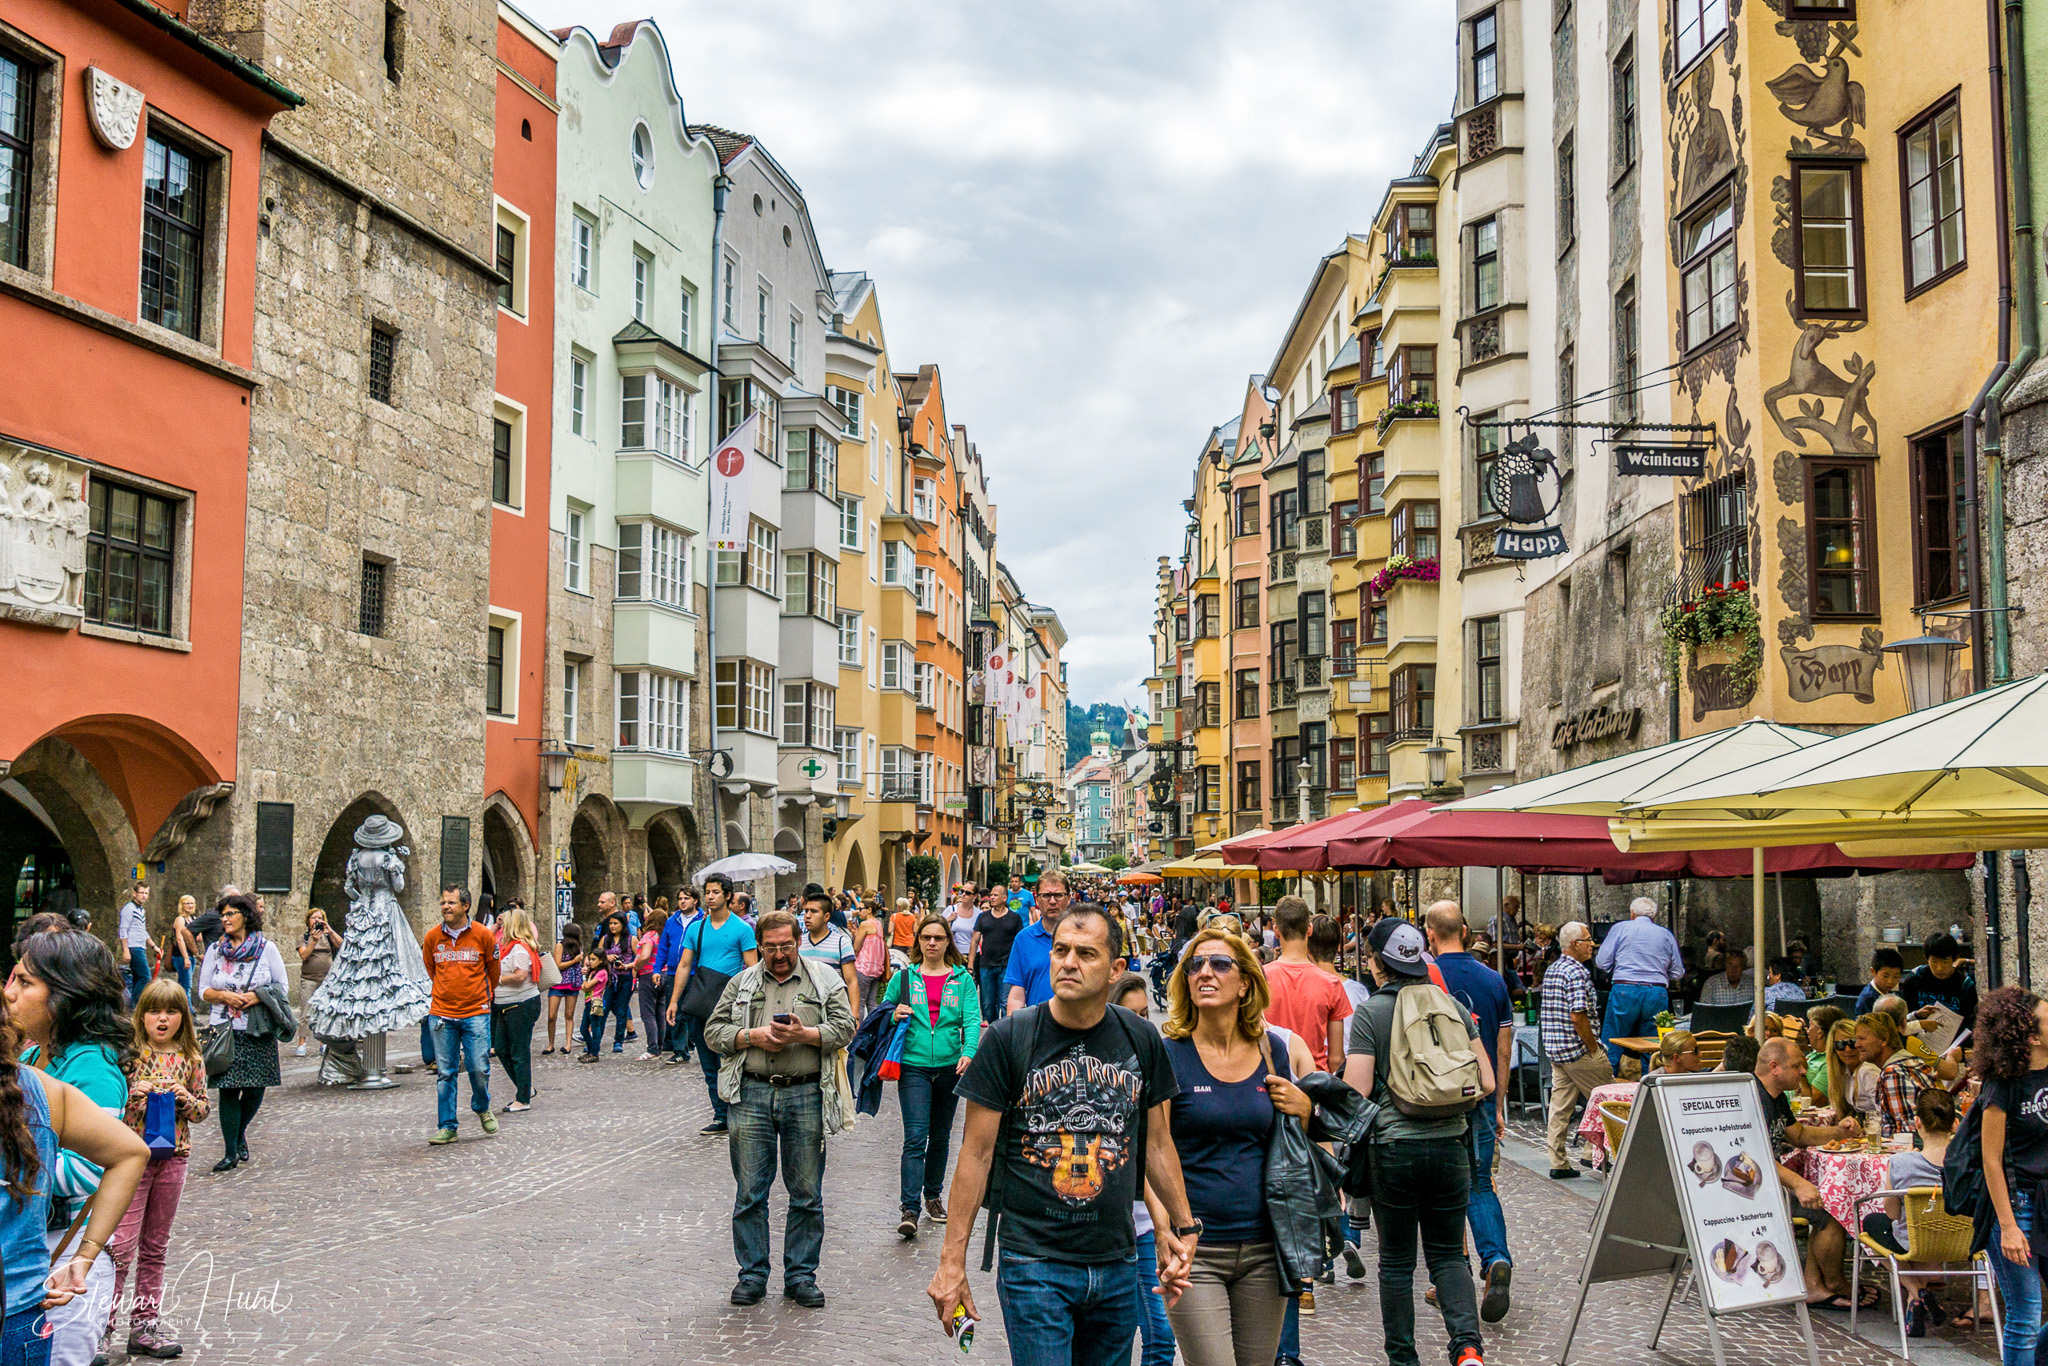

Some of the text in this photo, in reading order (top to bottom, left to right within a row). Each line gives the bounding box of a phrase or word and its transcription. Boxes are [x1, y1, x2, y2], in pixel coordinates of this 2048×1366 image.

[1626, 450, 1700, 467] Weinhaus
[1503, 534, 1561, 554] Happ
[1790, 653, 1863, 692] Happ
[1682, 1098, 1740, 1112] SPECIAL OFFER
[1060, 1112, 1079, 1124] Hard
[1681, 1126, 1714, 1136] Cappuccino
[1718, 1122, 1753, 1133] Apfelstrudel
[1703, 1216, 1735, 1227] Cappuccino
[1740, 1211, 1774, 1222] Sachertorte
